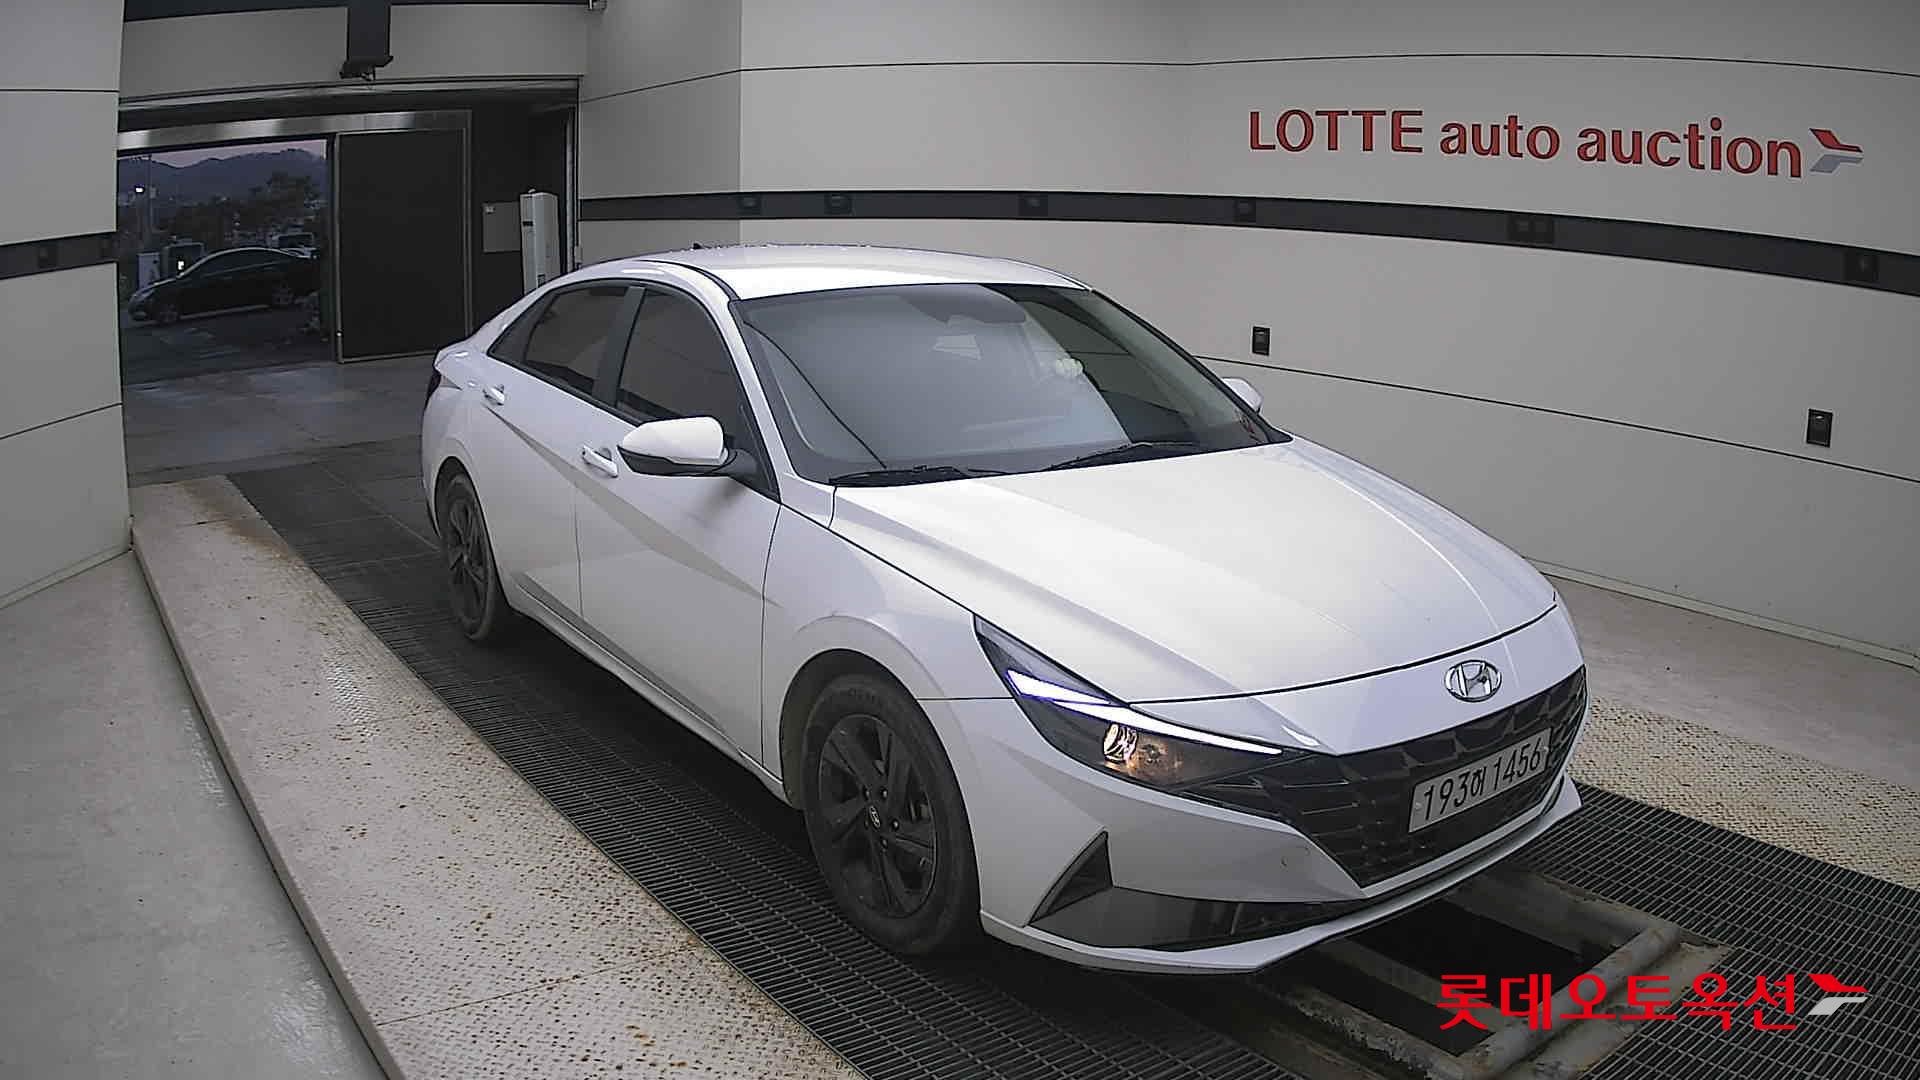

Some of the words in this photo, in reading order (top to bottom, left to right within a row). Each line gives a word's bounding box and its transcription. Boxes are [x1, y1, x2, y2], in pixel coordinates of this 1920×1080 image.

[1249, 109, 1424, 152] LOTTE
[1440, 115, 1560, 160] auto
[1577, 117, 1803, 178] auction
[1493, 738, 1542, 791] 1456
